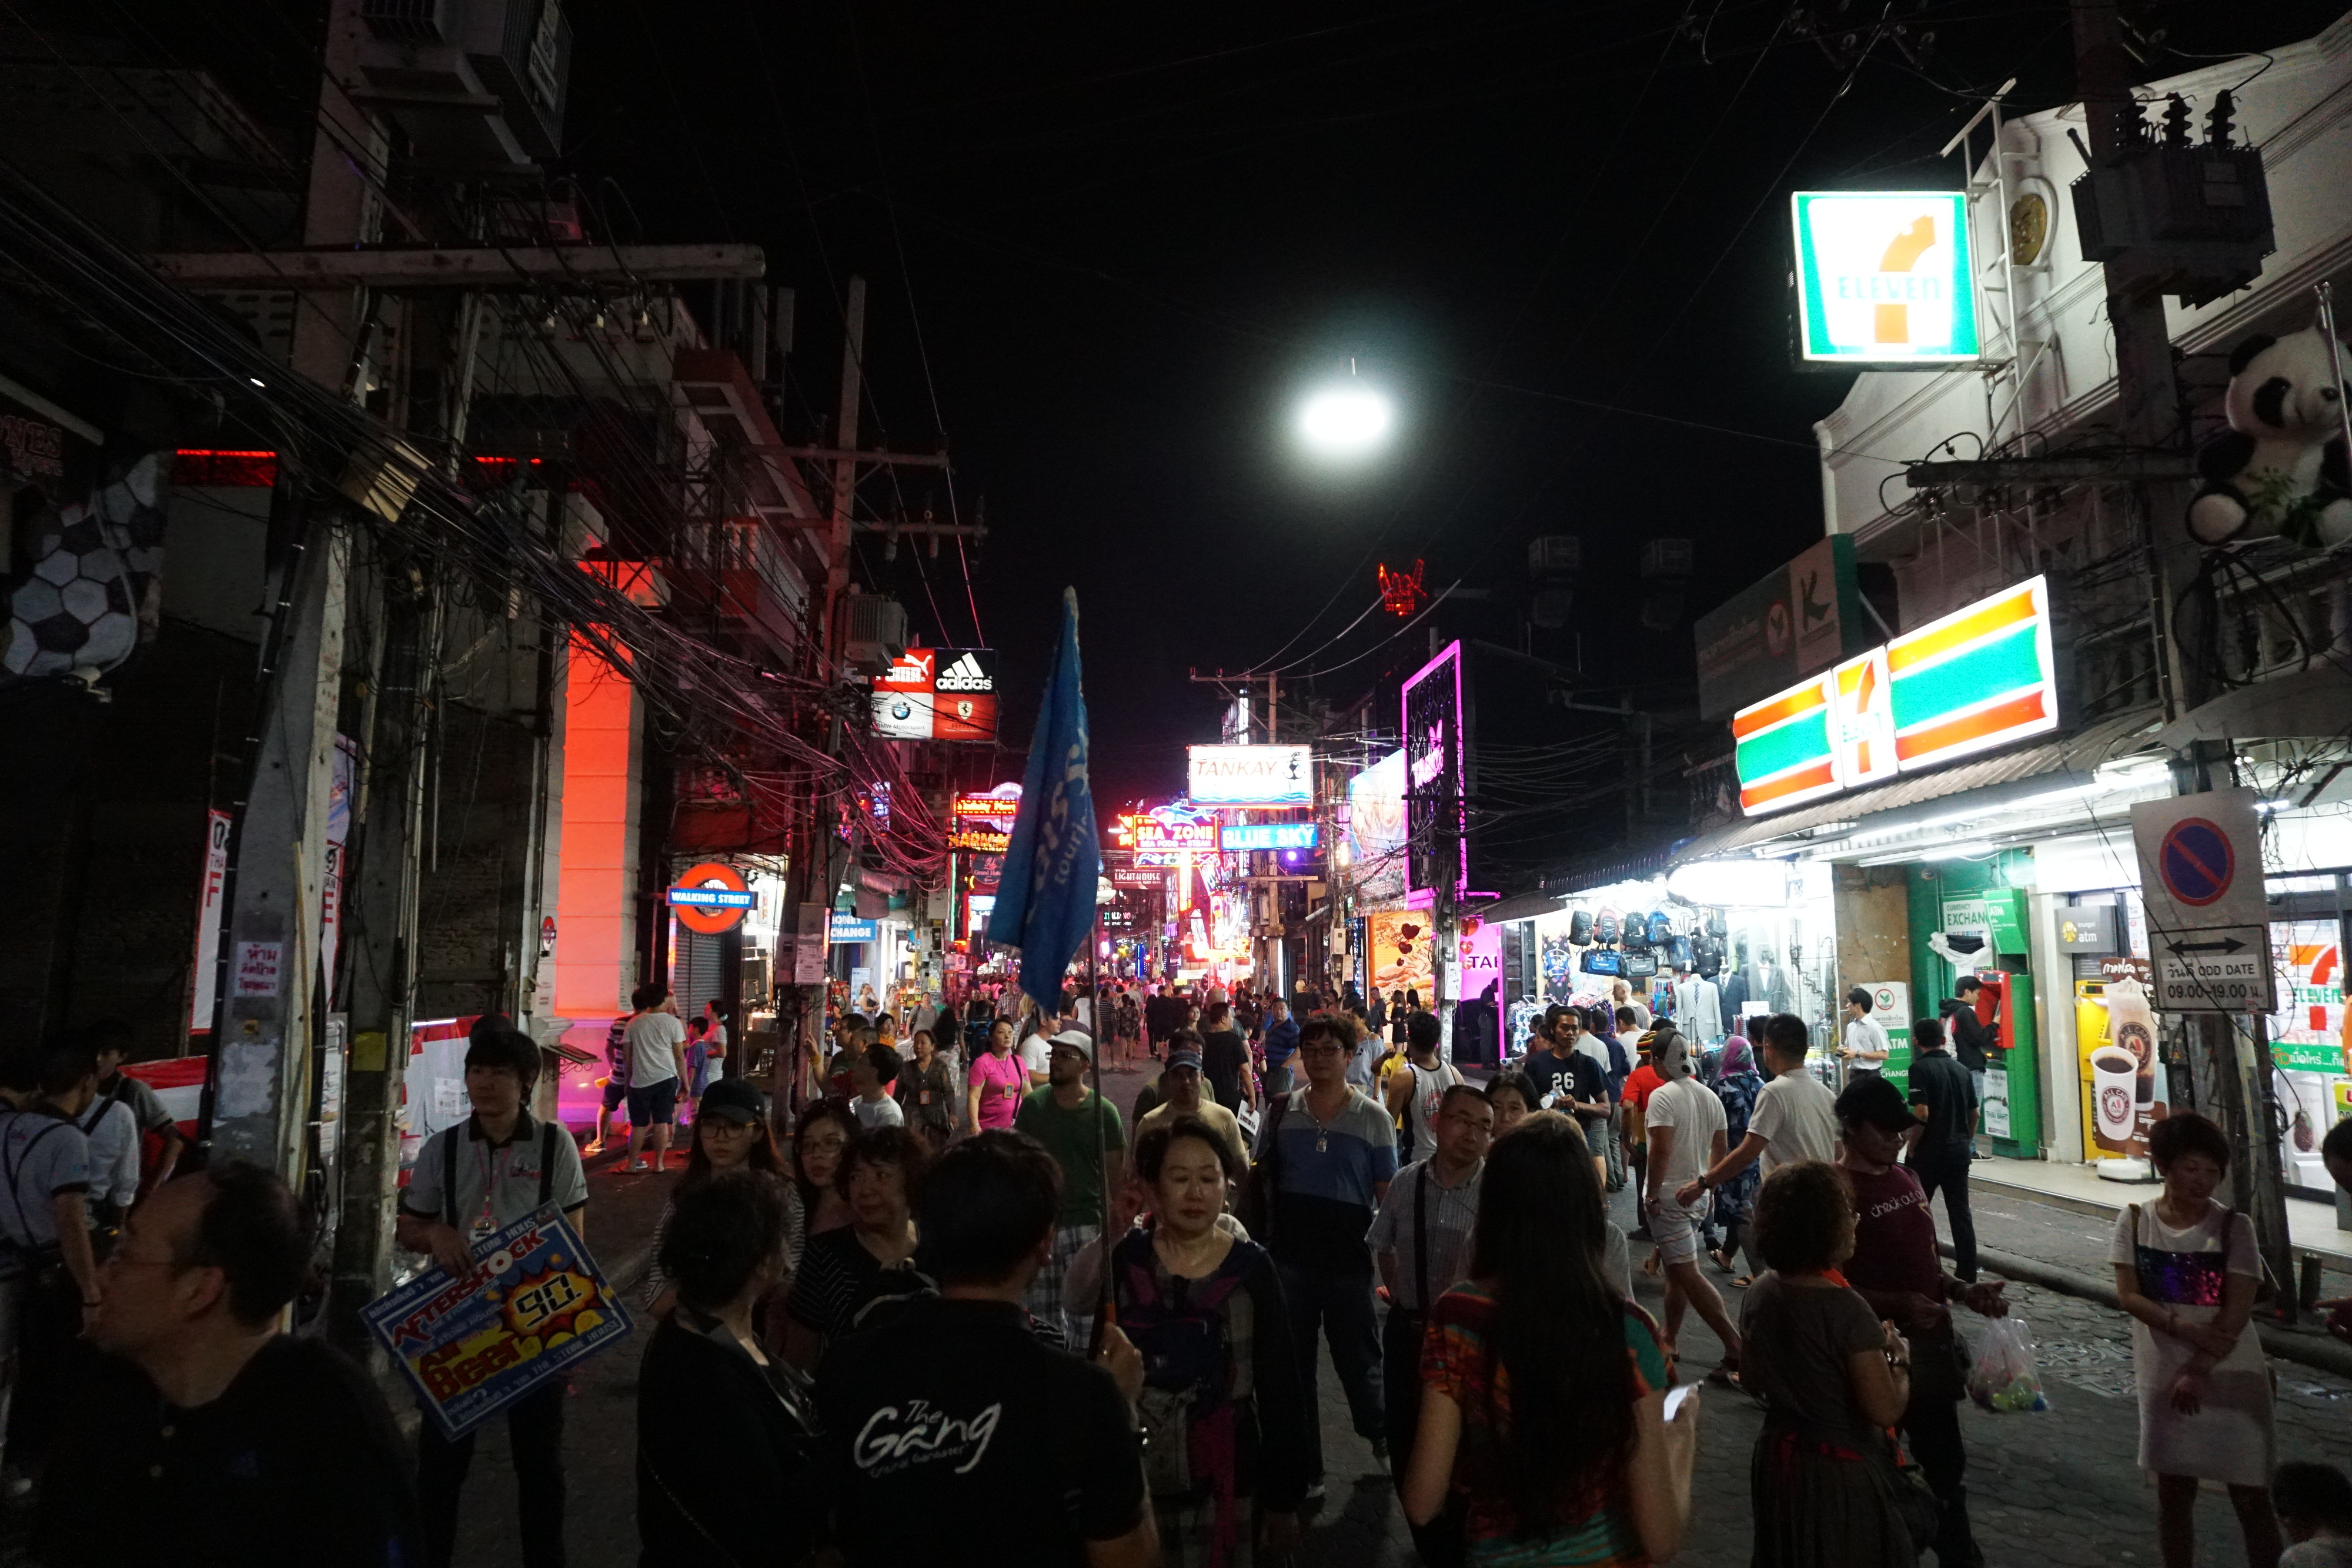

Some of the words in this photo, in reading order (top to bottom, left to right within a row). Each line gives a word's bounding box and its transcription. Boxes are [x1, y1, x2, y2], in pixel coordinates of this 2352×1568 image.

[936, 676, 993, 690] adidas
[1196, 761, 1278, 776] TANKAY
[1137, 825, 1165, 841] SEA
[1172, 825, 1214, 840] ZONE
[1222, 828, 1271, 849] BLUE
[1277, 827, 1315, 847] SKY
[1114, 872, 1161, 881] LIGHTHOUSE
[671, 891, 716, 903] WALKING
[717, 894, 751, 905] STREET
[1947, 911, 1986, 926] EXCHAN
[1989, 905, 2004, 917] ATM
[830, 925, 871, 938] CHANGE
[2078, 931, 2097, 942] atm
[2198, 965, 2221, 977] ODD
[2226, 964, 2256, 975] DATE
[1551, 1072, 1575, 1090] 26
[1880, 1069, 1909, 1078] CHANG
[1870, 1196, 1903, 1218] check
[505, 1215, 537, 1241] HOUS
[392, 1228, 549, 1348] AFTERSHOCK
[587, 1317, 622, 1343] HOUSE
[421, 1330, 524, 1403] Beer
[904, 1399, 943, 1424] The
[853, 1402, 1003, 1474] Gang
